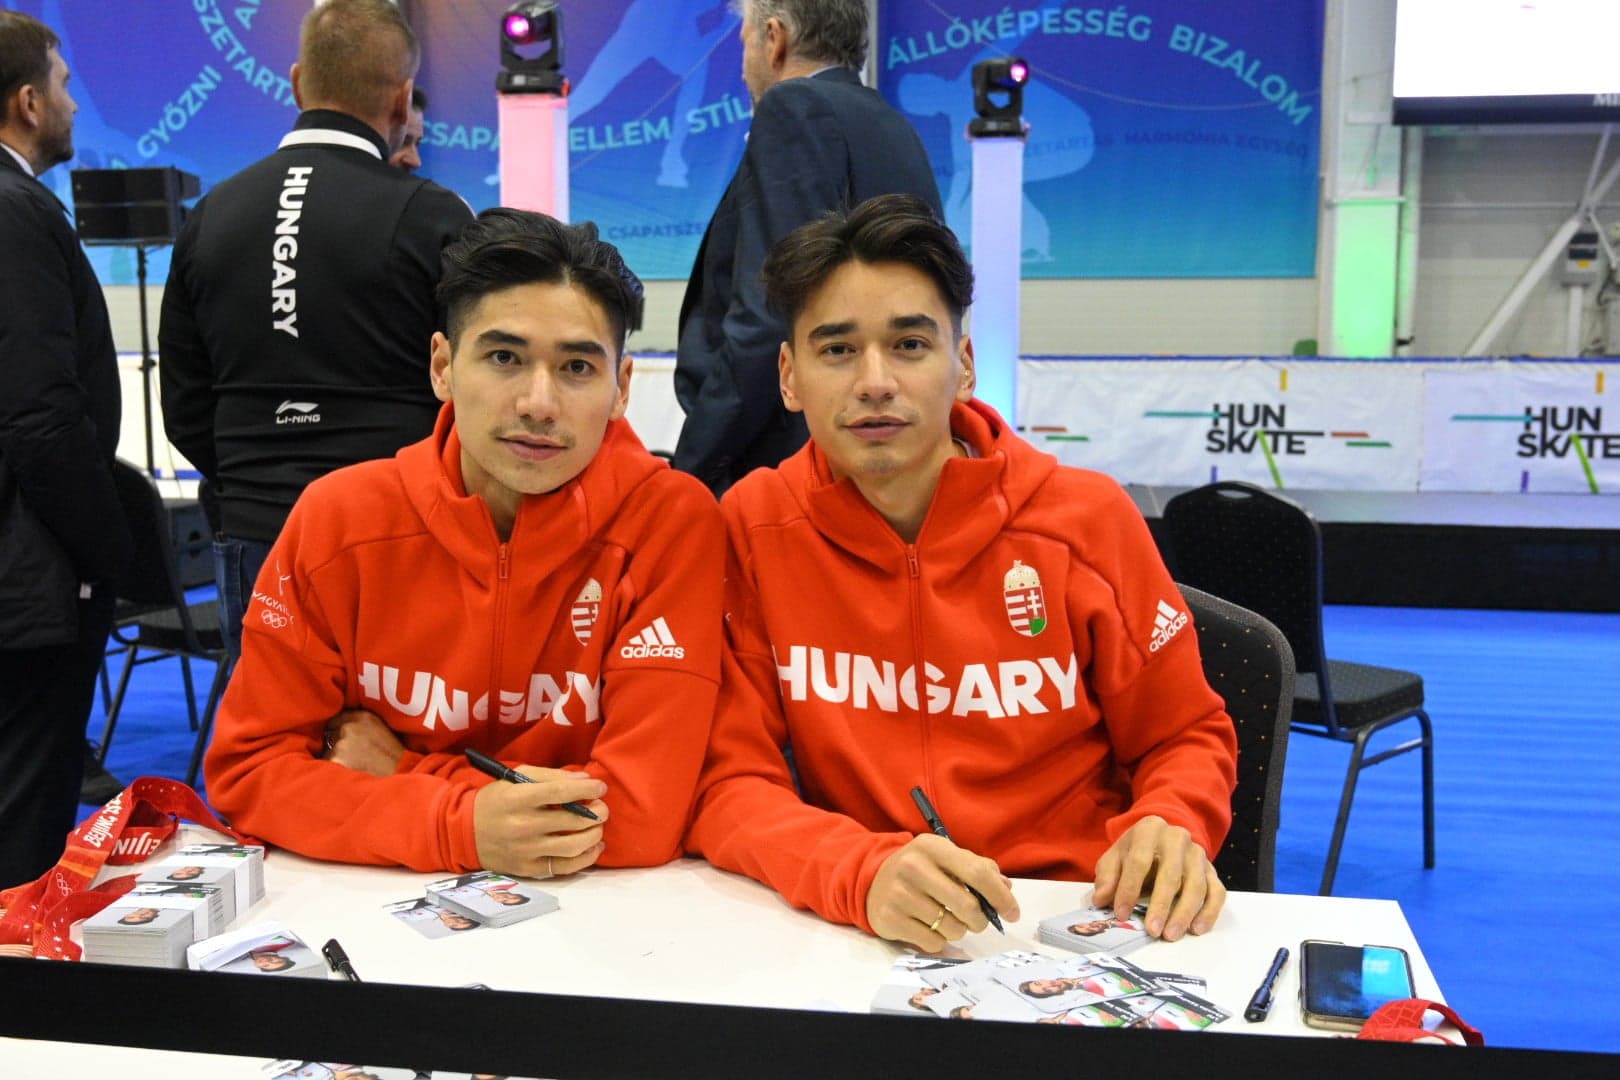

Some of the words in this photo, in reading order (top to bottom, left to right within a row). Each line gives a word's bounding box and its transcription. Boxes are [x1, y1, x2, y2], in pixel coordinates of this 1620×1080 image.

[887, 7, 1153, 70] ÁLLÓKÉPESSÉG
[1168, 24, 1314, 127] BIZALOM
[137, 64, 223, 159] GYŐZNI
[271, 166, 314, 338] HUNGARY
[275, 413, 321, 425] LI-NING
[1212, 403, 1286, 428] HUN
[1524, 406, 1602, 432] HUN
[1205, 429, 1306, 455] SKATE
[1516, 433, 1620, 459] SKATE
[1148, 611, 1189, 654] adidas
[620, 642, 685, 660] adidas
[772, 645, 1077, 719] HUNGARY
